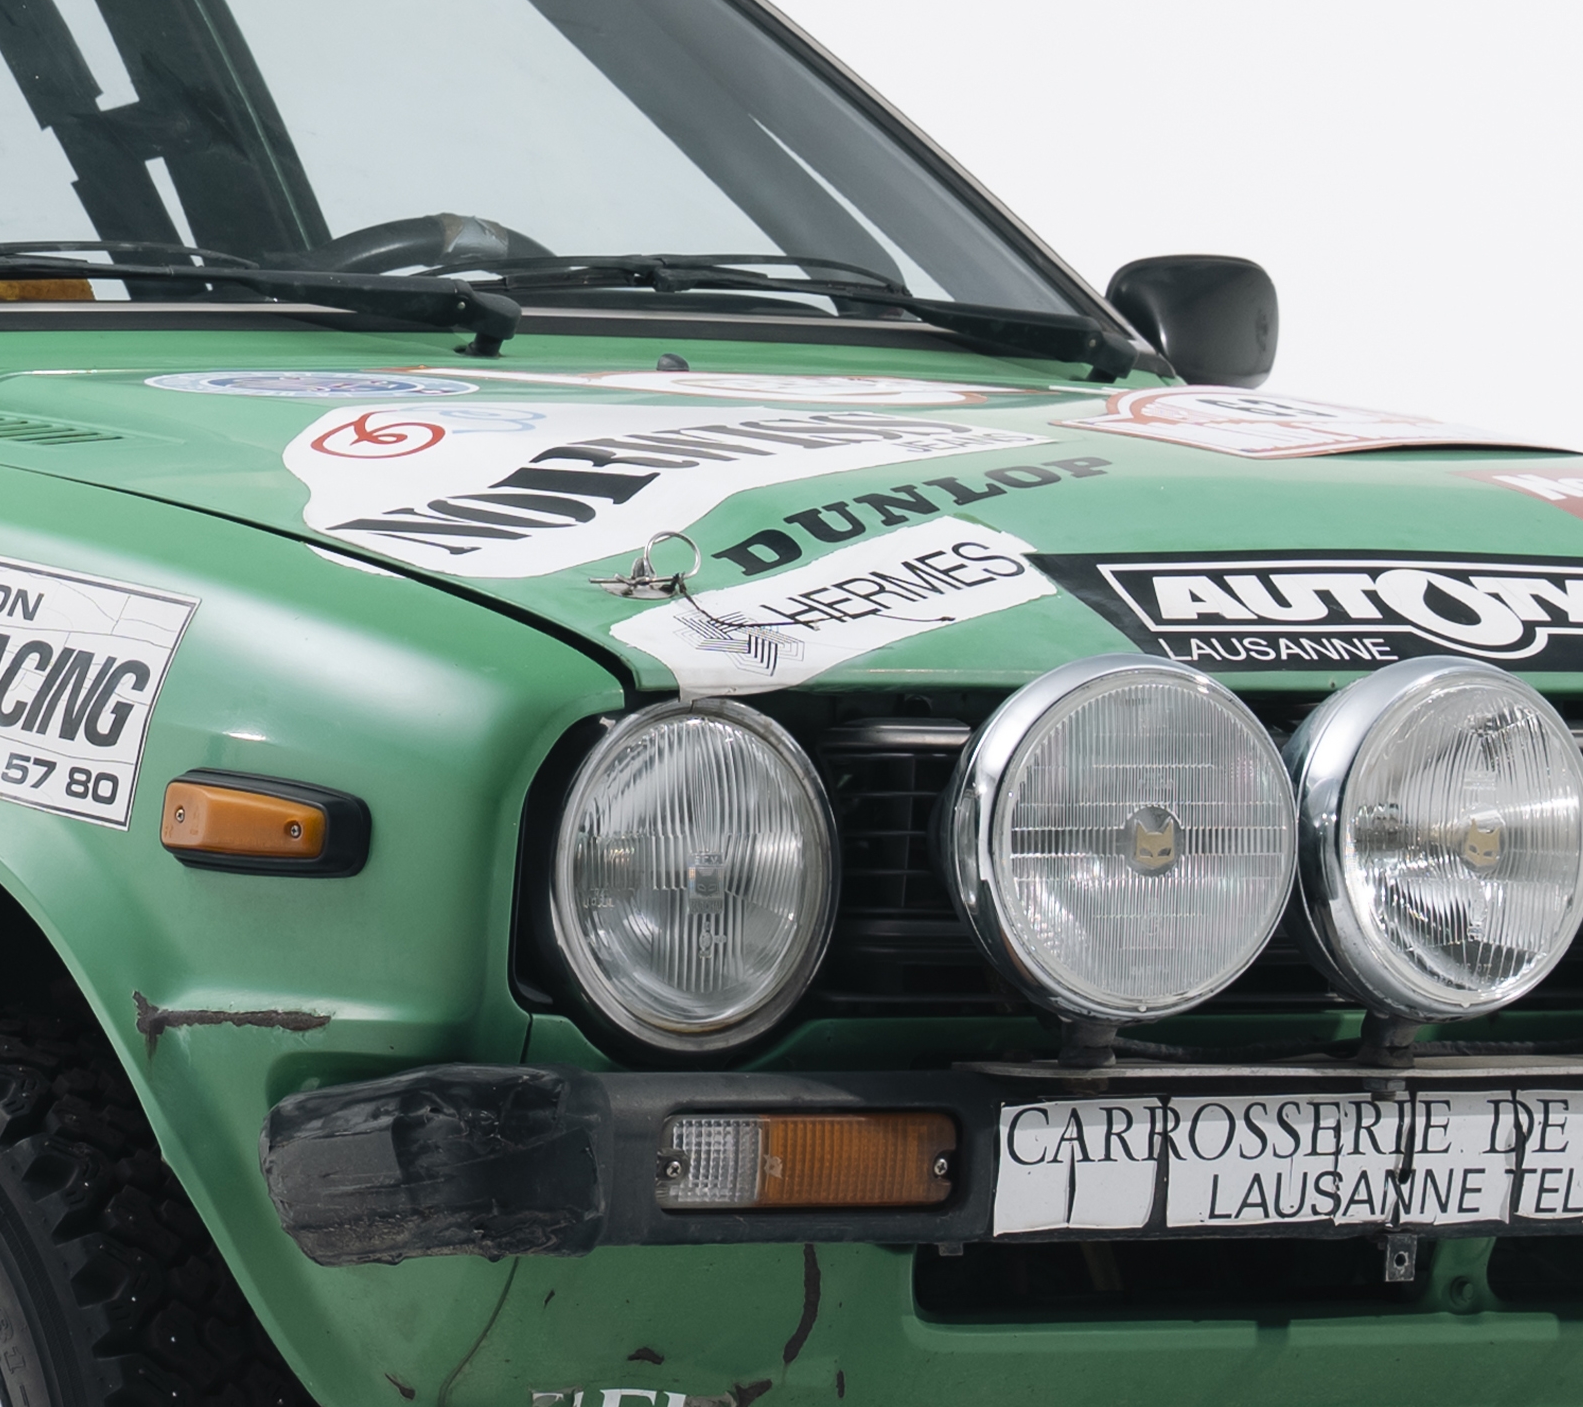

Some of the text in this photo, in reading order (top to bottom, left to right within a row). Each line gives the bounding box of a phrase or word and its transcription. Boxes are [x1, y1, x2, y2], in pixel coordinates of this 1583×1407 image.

[903, 431, 1036, 453] JEANS
[326, 413, 972, 555] NORWISS
[711, 456, 1113, 576] DUNLOP
[760, 542, 1026, 630] HERMES
[1158, 638, 1399, 662] LAUSANNE
[0, 754, 57, 789] 57
[65, 767, 119, 805] 80
[1007, 1099, 1452, 1166] CARROSSERIE
[1482, 1098, 1570, 1154] DE
[1208, 1168, 1486, 1220] LAUSANNE
